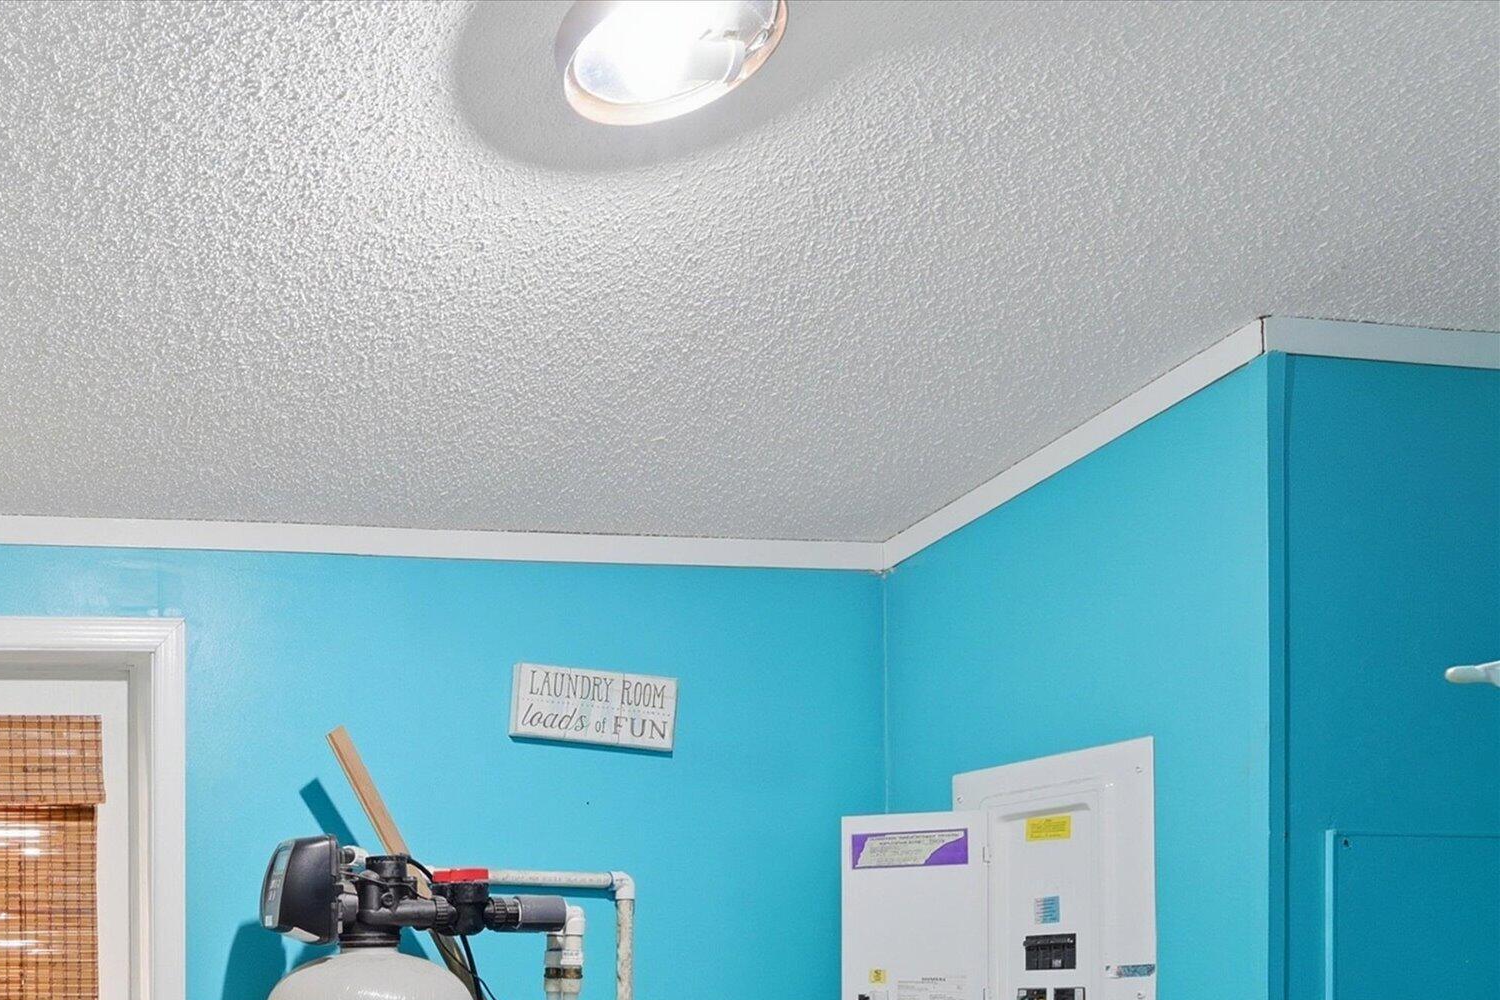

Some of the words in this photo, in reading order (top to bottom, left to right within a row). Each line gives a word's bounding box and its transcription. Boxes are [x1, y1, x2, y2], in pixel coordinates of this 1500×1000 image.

[529, 670, 615, 703] LAUNDRY
[621, 679, 667, 709] ROOM
[521, 703, 590, 732] loads
[594, 717, 607, 734] of
[613, 715, 668, 740] FUN
